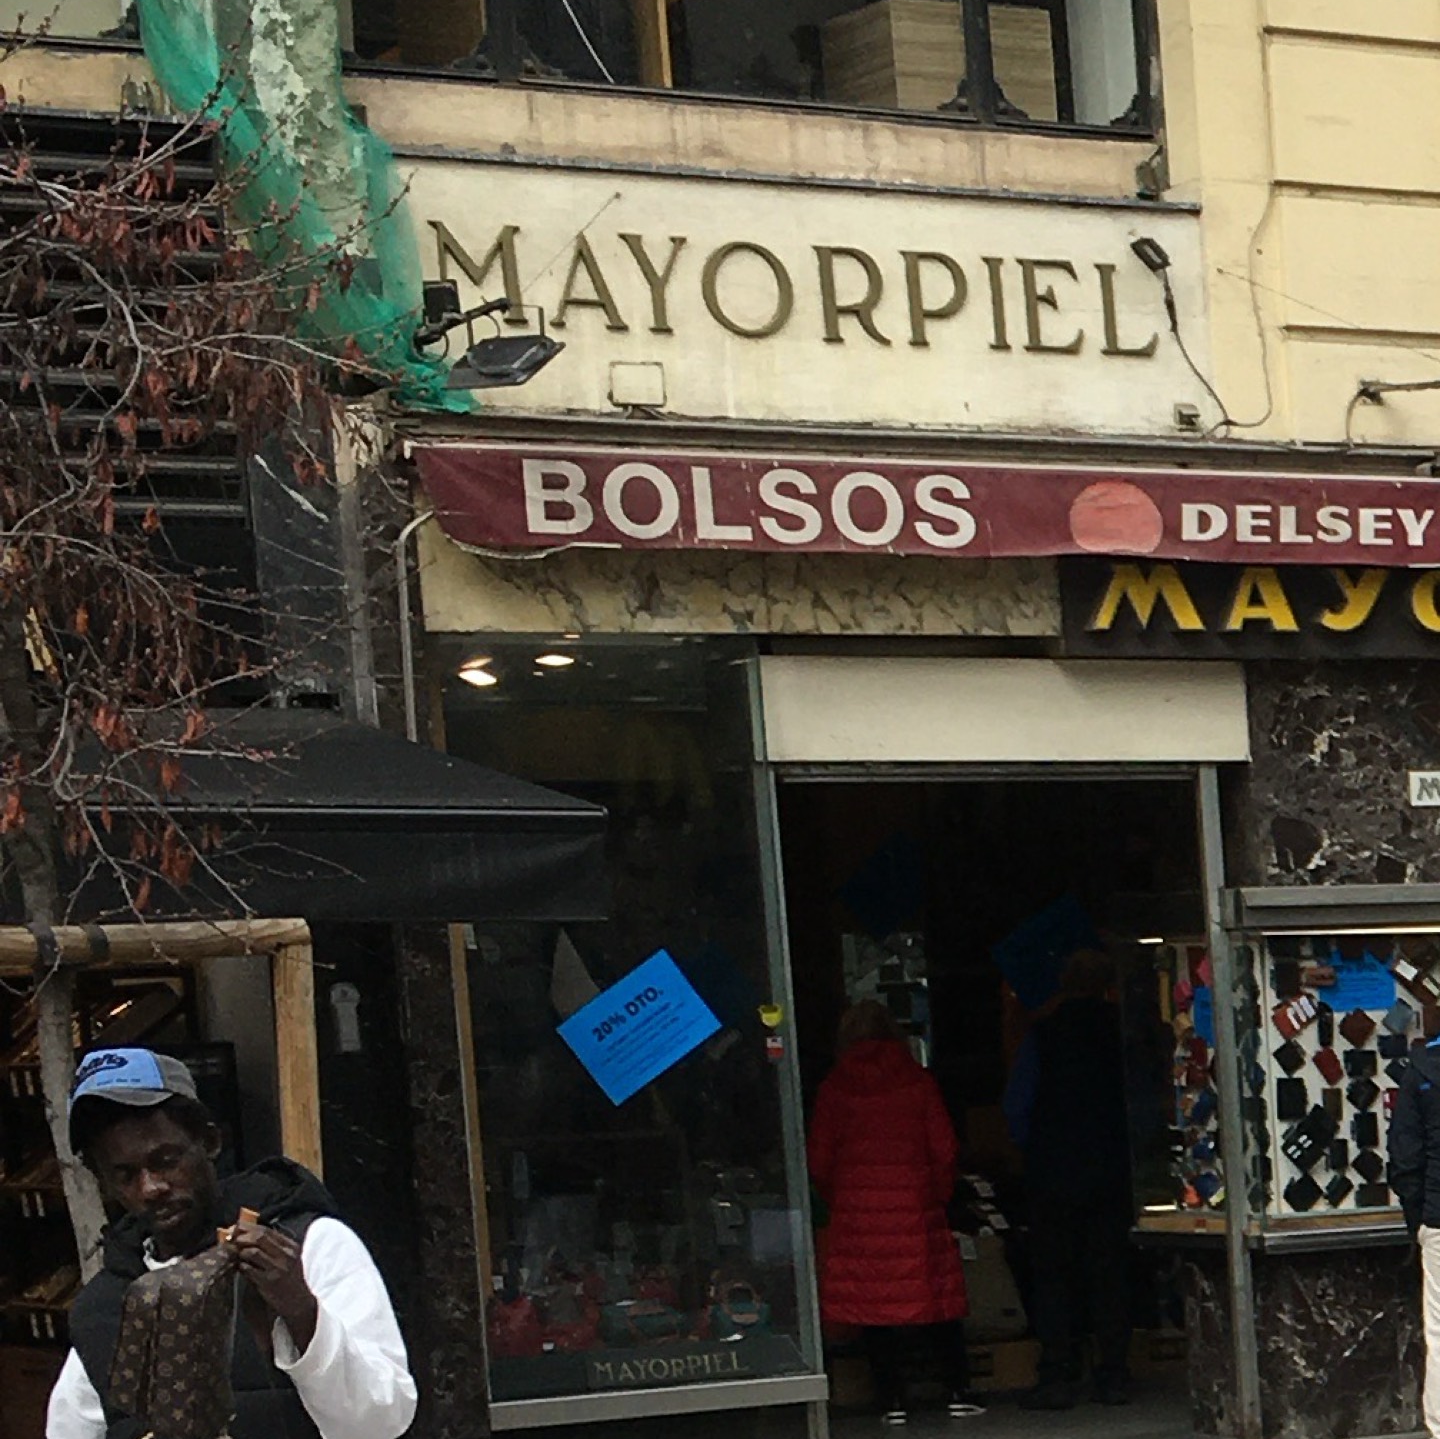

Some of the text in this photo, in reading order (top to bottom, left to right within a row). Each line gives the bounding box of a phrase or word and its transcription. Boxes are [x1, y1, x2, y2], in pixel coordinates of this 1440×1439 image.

[427, 219, 1160, 357] MAYORPIEL
[521, 458, 978, 549] BOLSOS
[1179, 502, 1434, 547] DELSEY
[592, 1012, 627, 1042] 20%
[595, 1351, 749, 1381] MAYORPIEL
